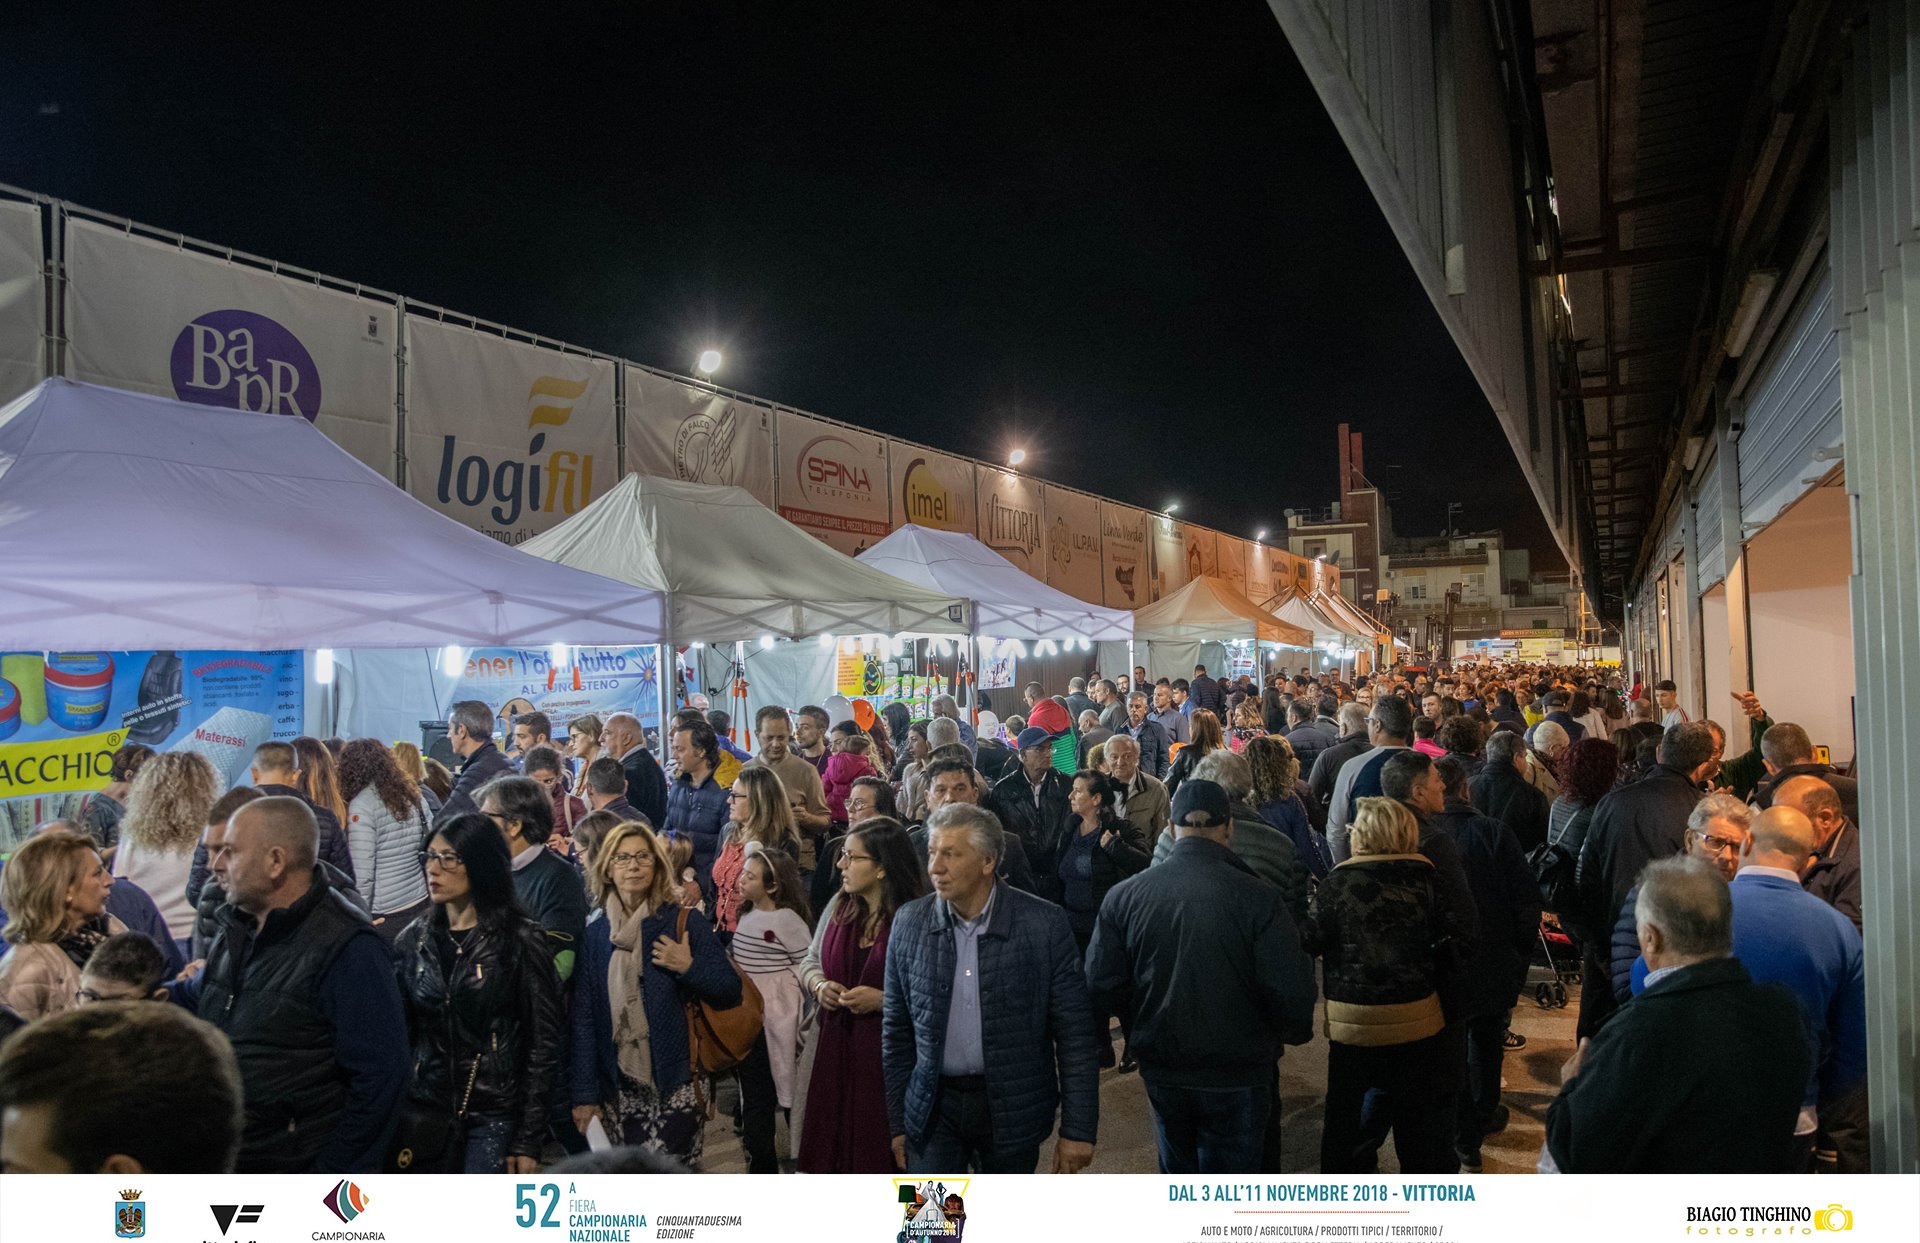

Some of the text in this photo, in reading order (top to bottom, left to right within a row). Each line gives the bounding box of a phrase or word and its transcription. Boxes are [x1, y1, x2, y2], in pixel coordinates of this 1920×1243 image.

[688, 421, 710, 431] FALCO
[437, 433, 594, 525] logifil
[808, 457, 871, 491] SPINA
[808, 485, 871, 502] TELEFONIA
[822, 516, 841, 528] SEMPRE
[986, 493, 1041, 554] VITTORIA
[1122, 525, 1144, 543] Verde
[521, 682, 537, 695] AL
[142, 702, 156, 711] auto
[278, 702, 295, 710] erba
[195, 728, 247, 748] Materassi
